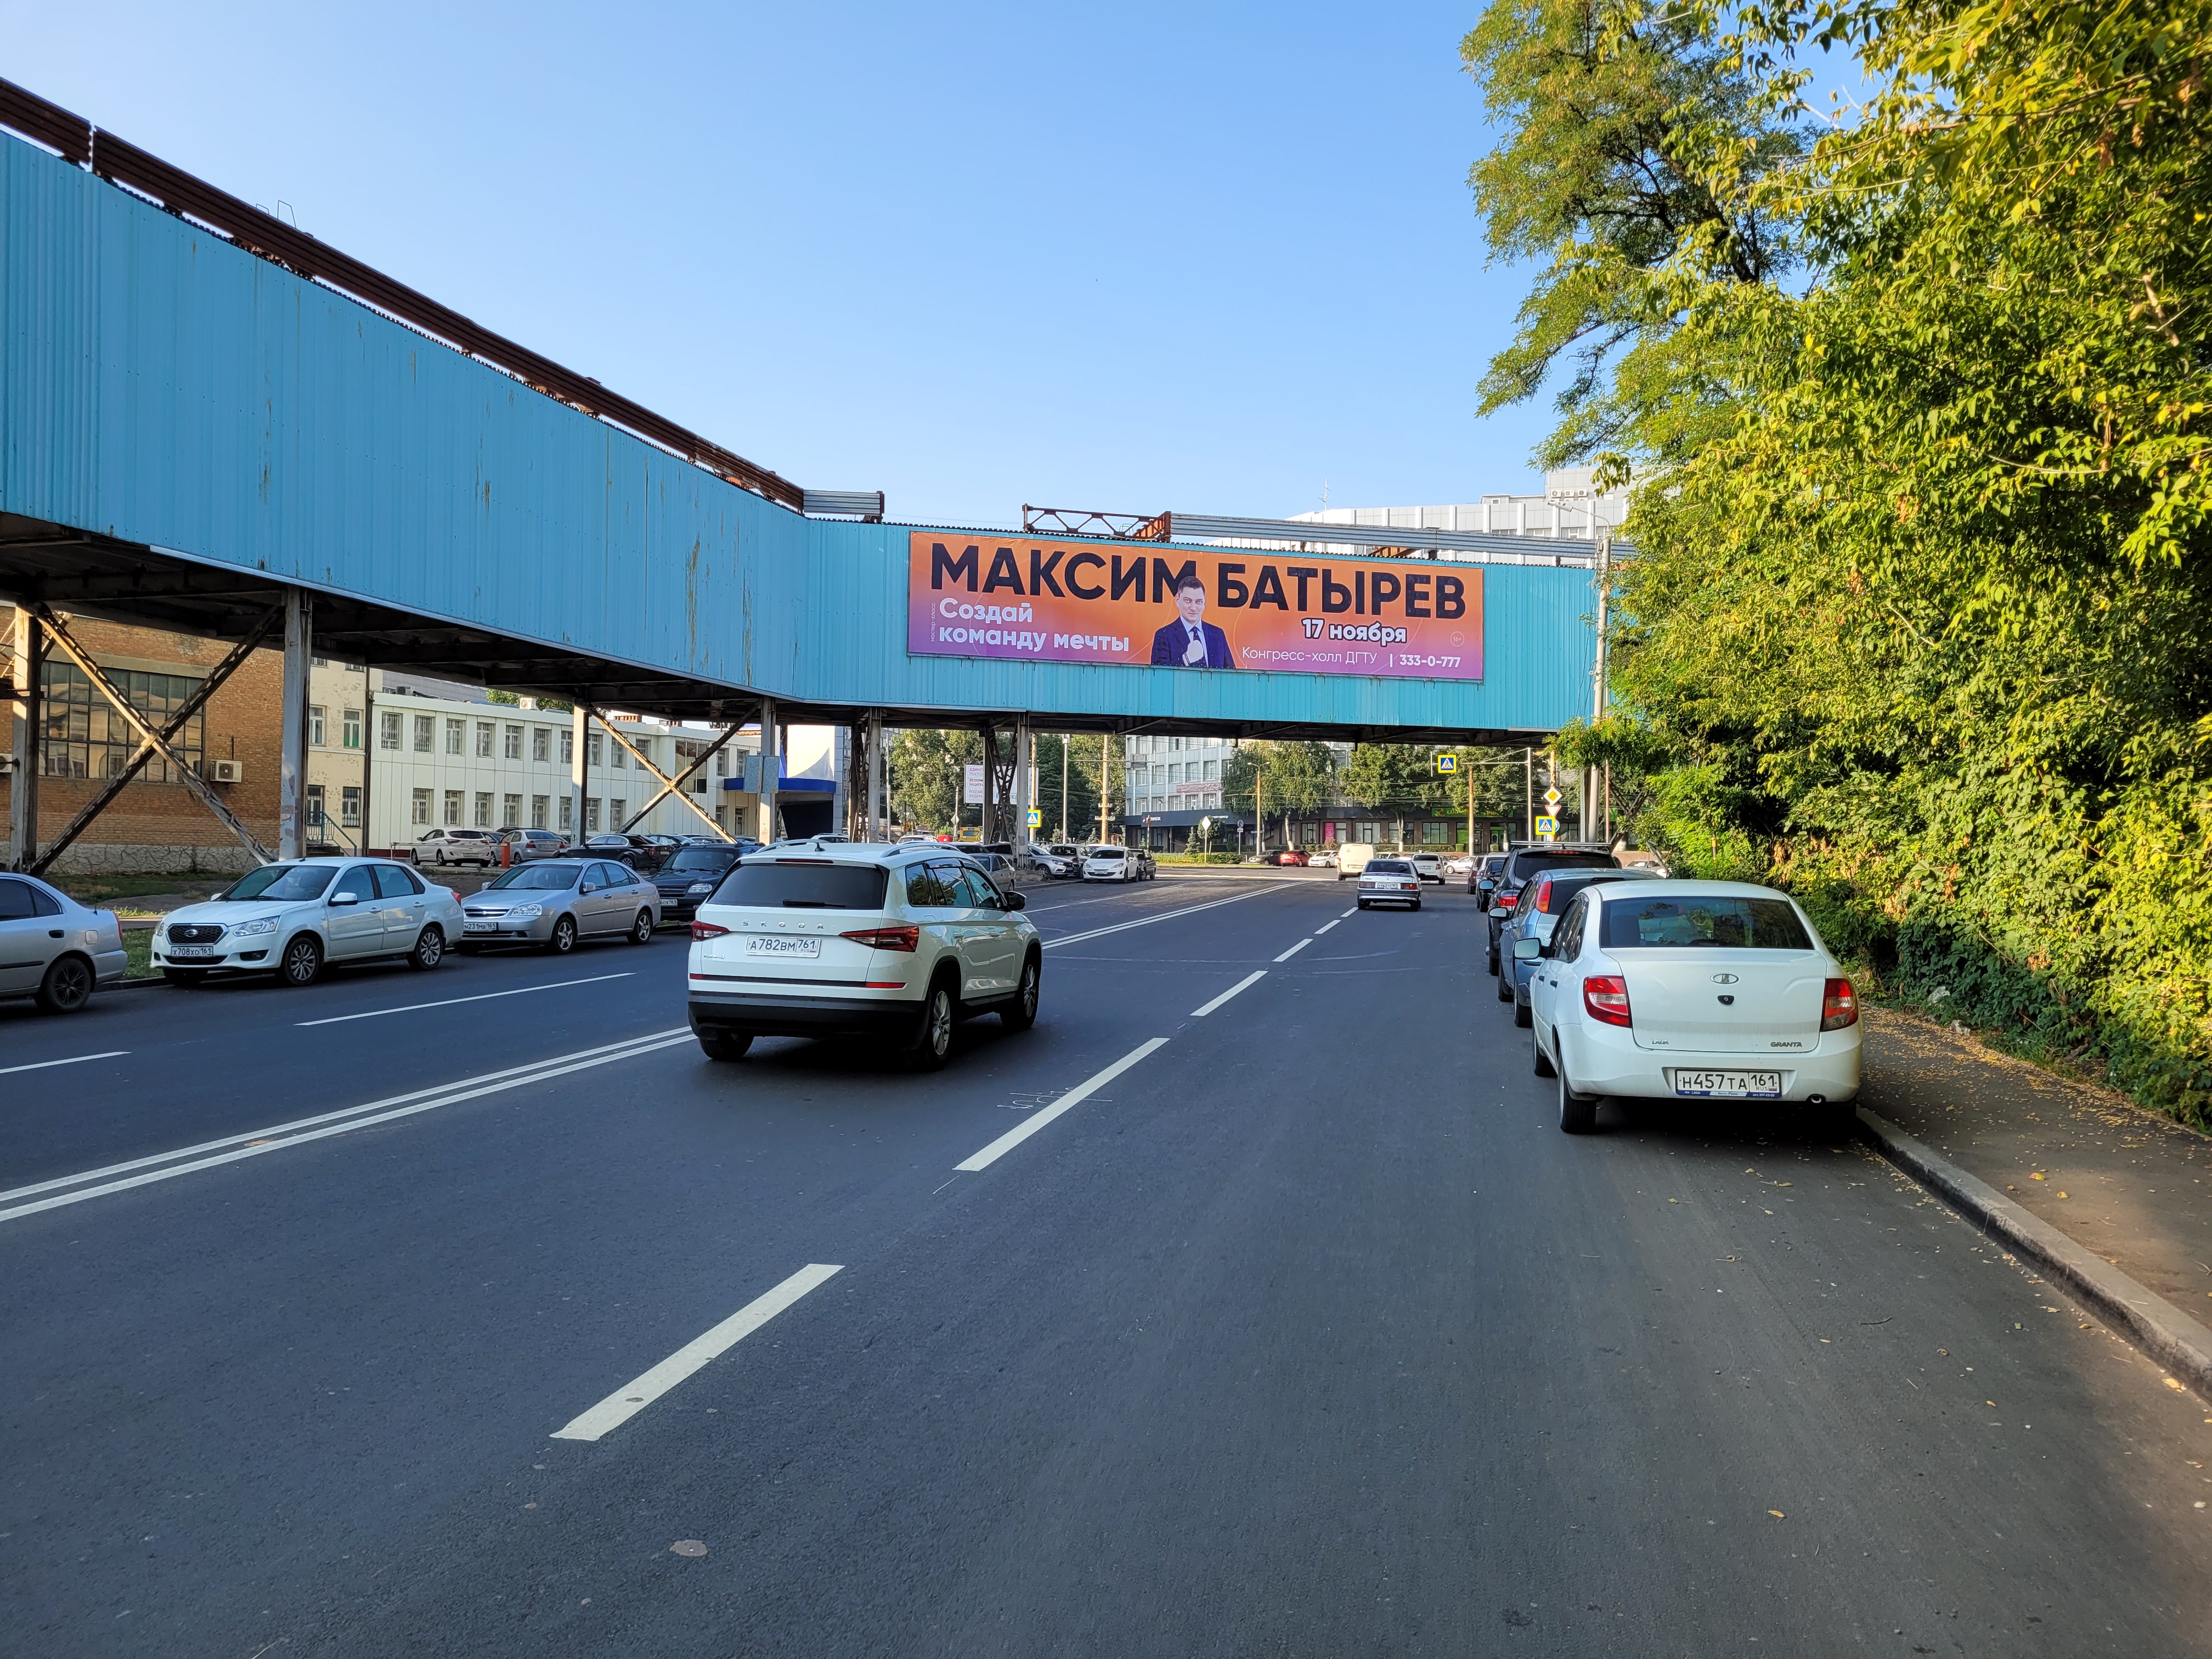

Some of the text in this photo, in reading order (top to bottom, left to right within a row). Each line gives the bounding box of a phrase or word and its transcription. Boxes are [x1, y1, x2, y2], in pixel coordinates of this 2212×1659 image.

[931, 543, 1466, 620] МАКСИМ БАТЫРЕВ
[939, 597, 1032, 624] Создай
[939, 627, 1129, 652] команду мечты
[1302, 618, 1407, 647] 17 ноября
[1242, 646, 1378, 665] Конгресс-холл ДГТУ
[1400, 654, 1461, 668] 333-0-777
[750, 938, 816, 951] А782ВМ 761
[1682, 1073, 1775, 1091] Н457ТА 161
